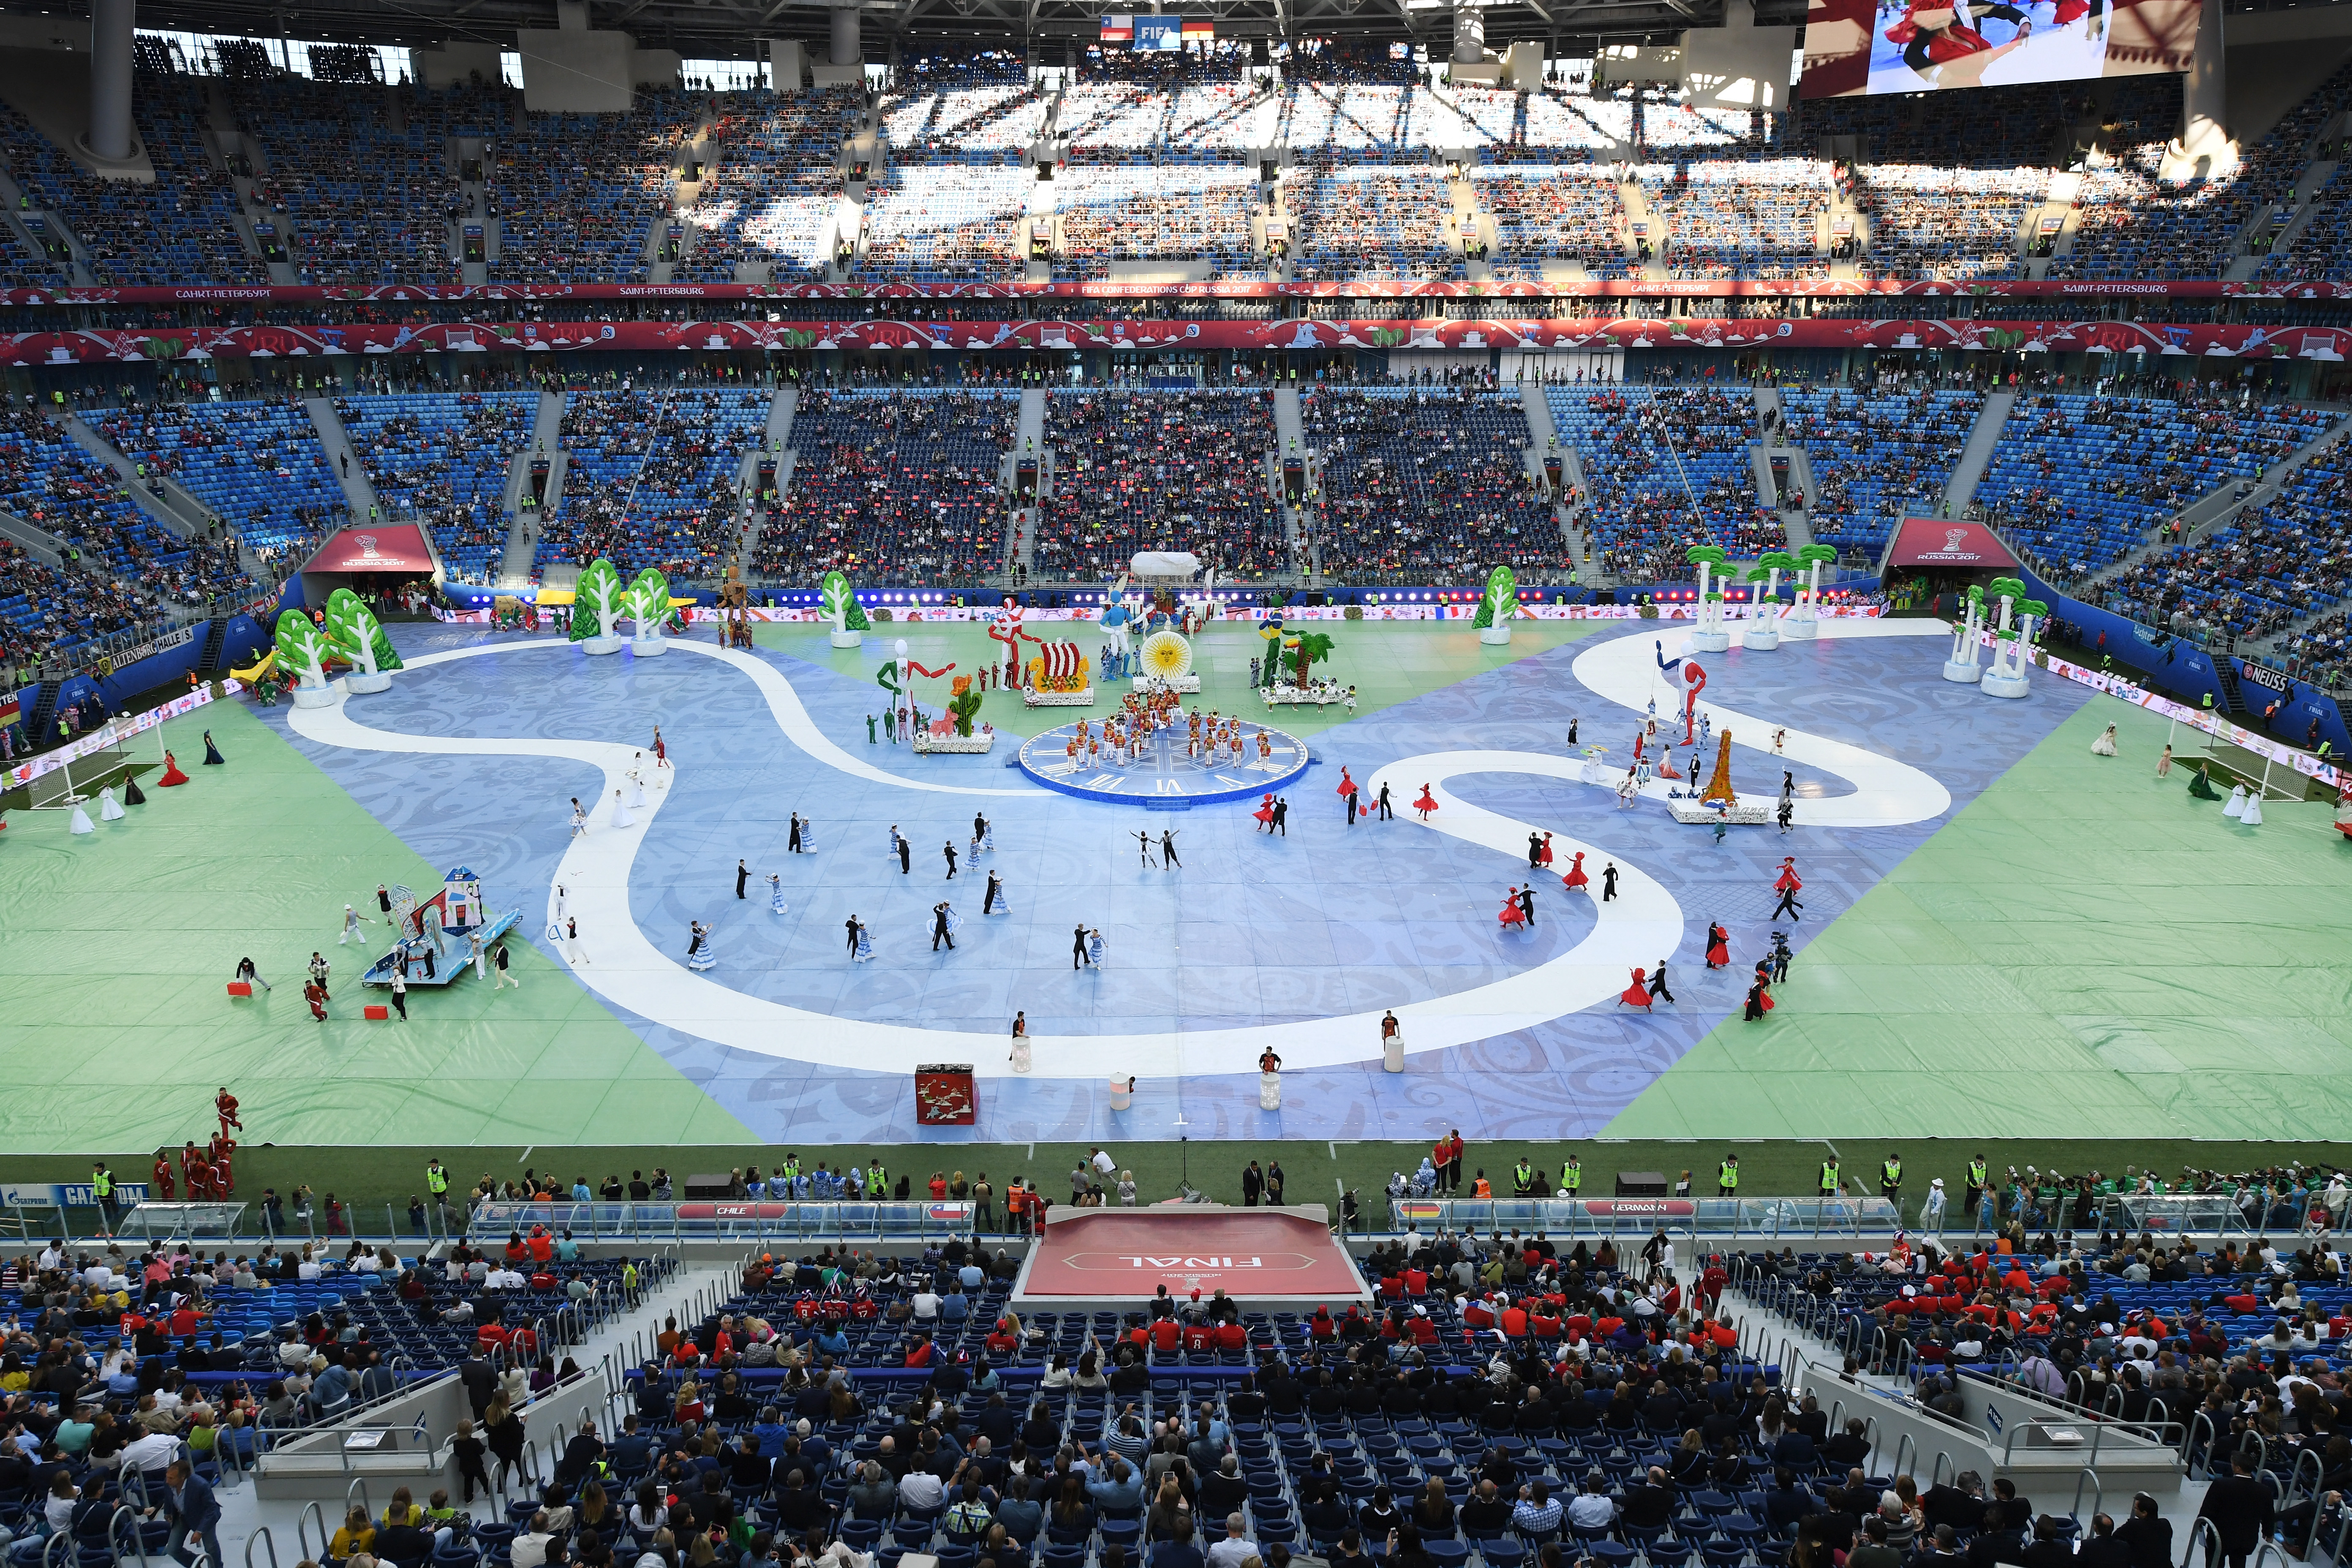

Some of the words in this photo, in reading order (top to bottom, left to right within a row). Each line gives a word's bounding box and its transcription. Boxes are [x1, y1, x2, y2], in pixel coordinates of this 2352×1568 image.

[1141, 27, 1174, 39] FIFA
[176, 289, 272, 298] САНКТ-ПЕТЕРБУРГ
[1082, 286, 1100, 294] FIFA
[1102, 286, 1178, 294] CONFEDERATIONS
[1179, 286, 1198, 294] CUP
[1199, 286, 1230, 294] RUSSIA
[1232, 286, 1252, 294] 2017
[2062, 285, 2167, 293] SAINT-PETERSBURG
[157, 633, 181, 651] HALLE
[185, 629, 193, 640] S.
[2189, 661, 2201, 670] FINAL
[2251, 667, 2287, 692] NEUSS
[71, 689, 85, 698] FINAL
[2116, 685, 2140, 699] Paris
[2308, 706, 2323, 716] FINAL
[948, 734, 988, 744] Mexico
[1726, 801, 1770, 815] France
[65, 1186, 144, 1205] GAZOM
[1119, 1257, 1262, 1267] FINAL
[1903, 1251, 1908, 1263] 7
[828, 1310, 841, 1319] 10
[123, 1323, 131, 1336] 8
[2341, 1327, 2349, 1338] 7
[1193, 1339, 1201, 1349] 8
[1988, 1409, 2002, 1428] A106
